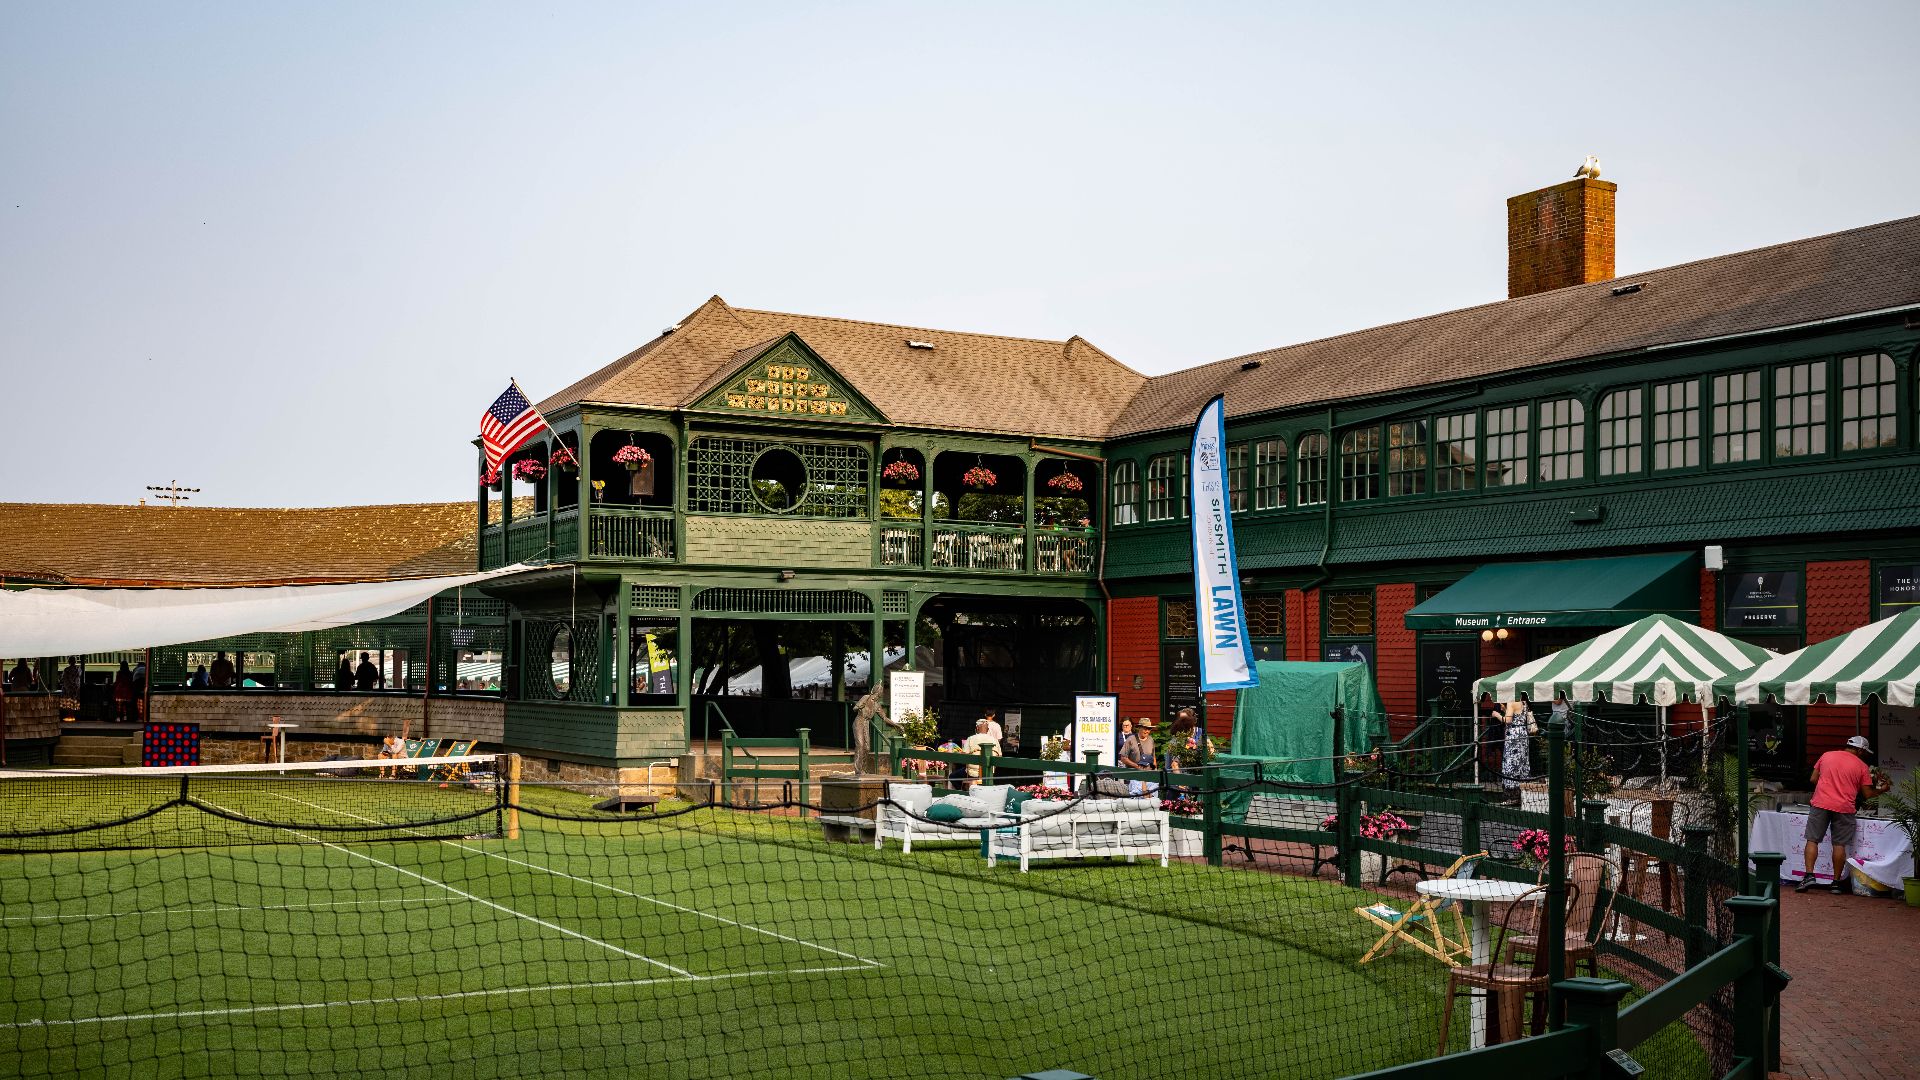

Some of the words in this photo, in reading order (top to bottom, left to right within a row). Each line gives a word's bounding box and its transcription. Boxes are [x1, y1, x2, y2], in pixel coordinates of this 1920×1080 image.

[1211, 498, 1228, 575] SIPSMITH
[1211, 585, 1239, 649] LAWN
[1455, 617, 1489, 626] Museum
[1507, 616, 1547, 625] Entrance
[1081, 723, 1110, 733] RALLIES
